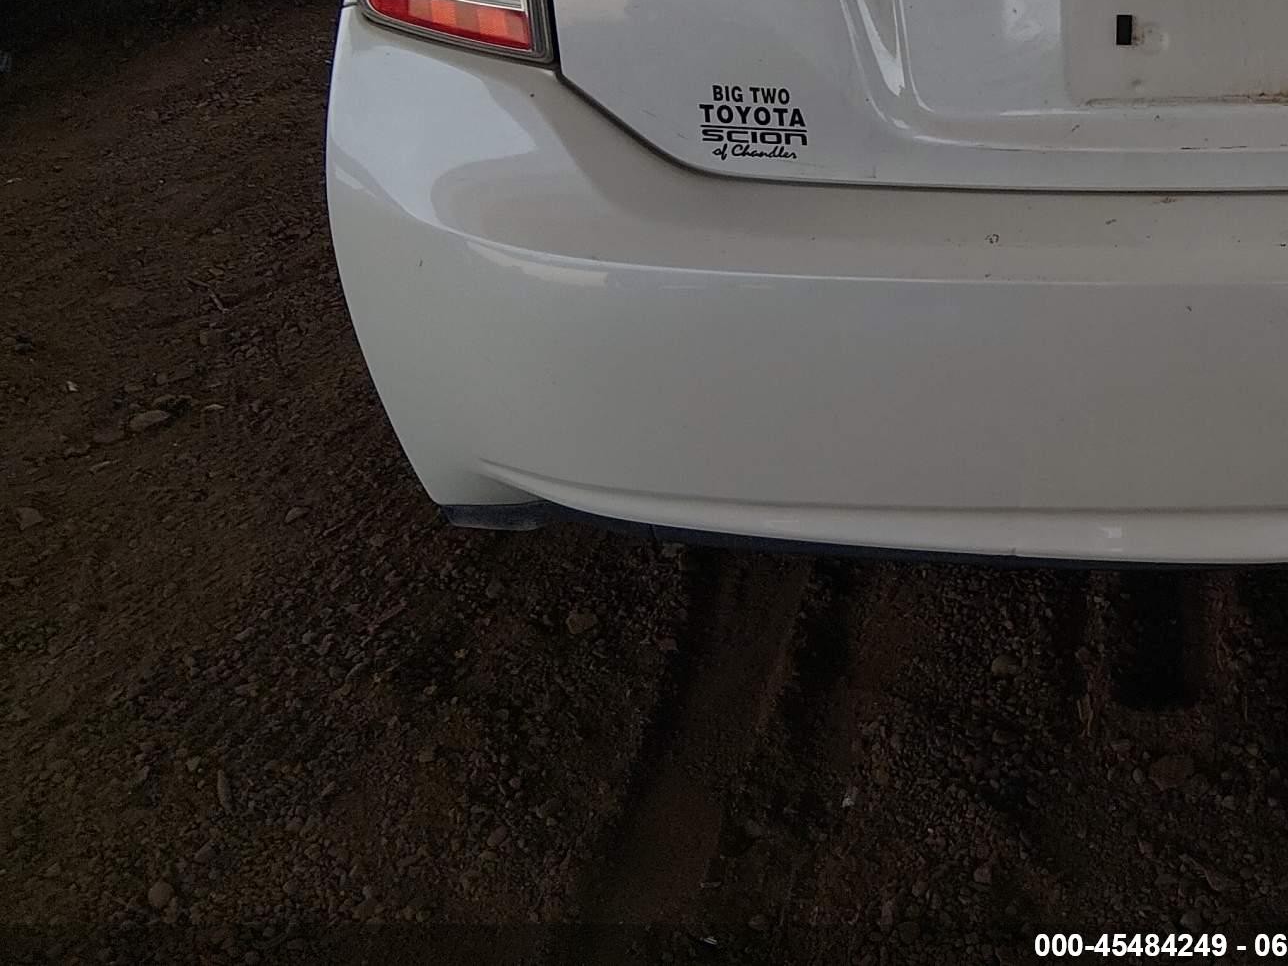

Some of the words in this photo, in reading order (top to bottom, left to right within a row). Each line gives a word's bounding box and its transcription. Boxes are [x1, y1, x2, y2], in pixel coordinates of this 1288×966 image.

[712, 85, 744, 103] BIG
[749, 87, 790, 105] TWO
[699, 104, 806, 127] TOYOTA
[701, 129, 808, 146] SCION
[712, 143, 728, 161] of
[731, 144, 798, 159] Chandler
